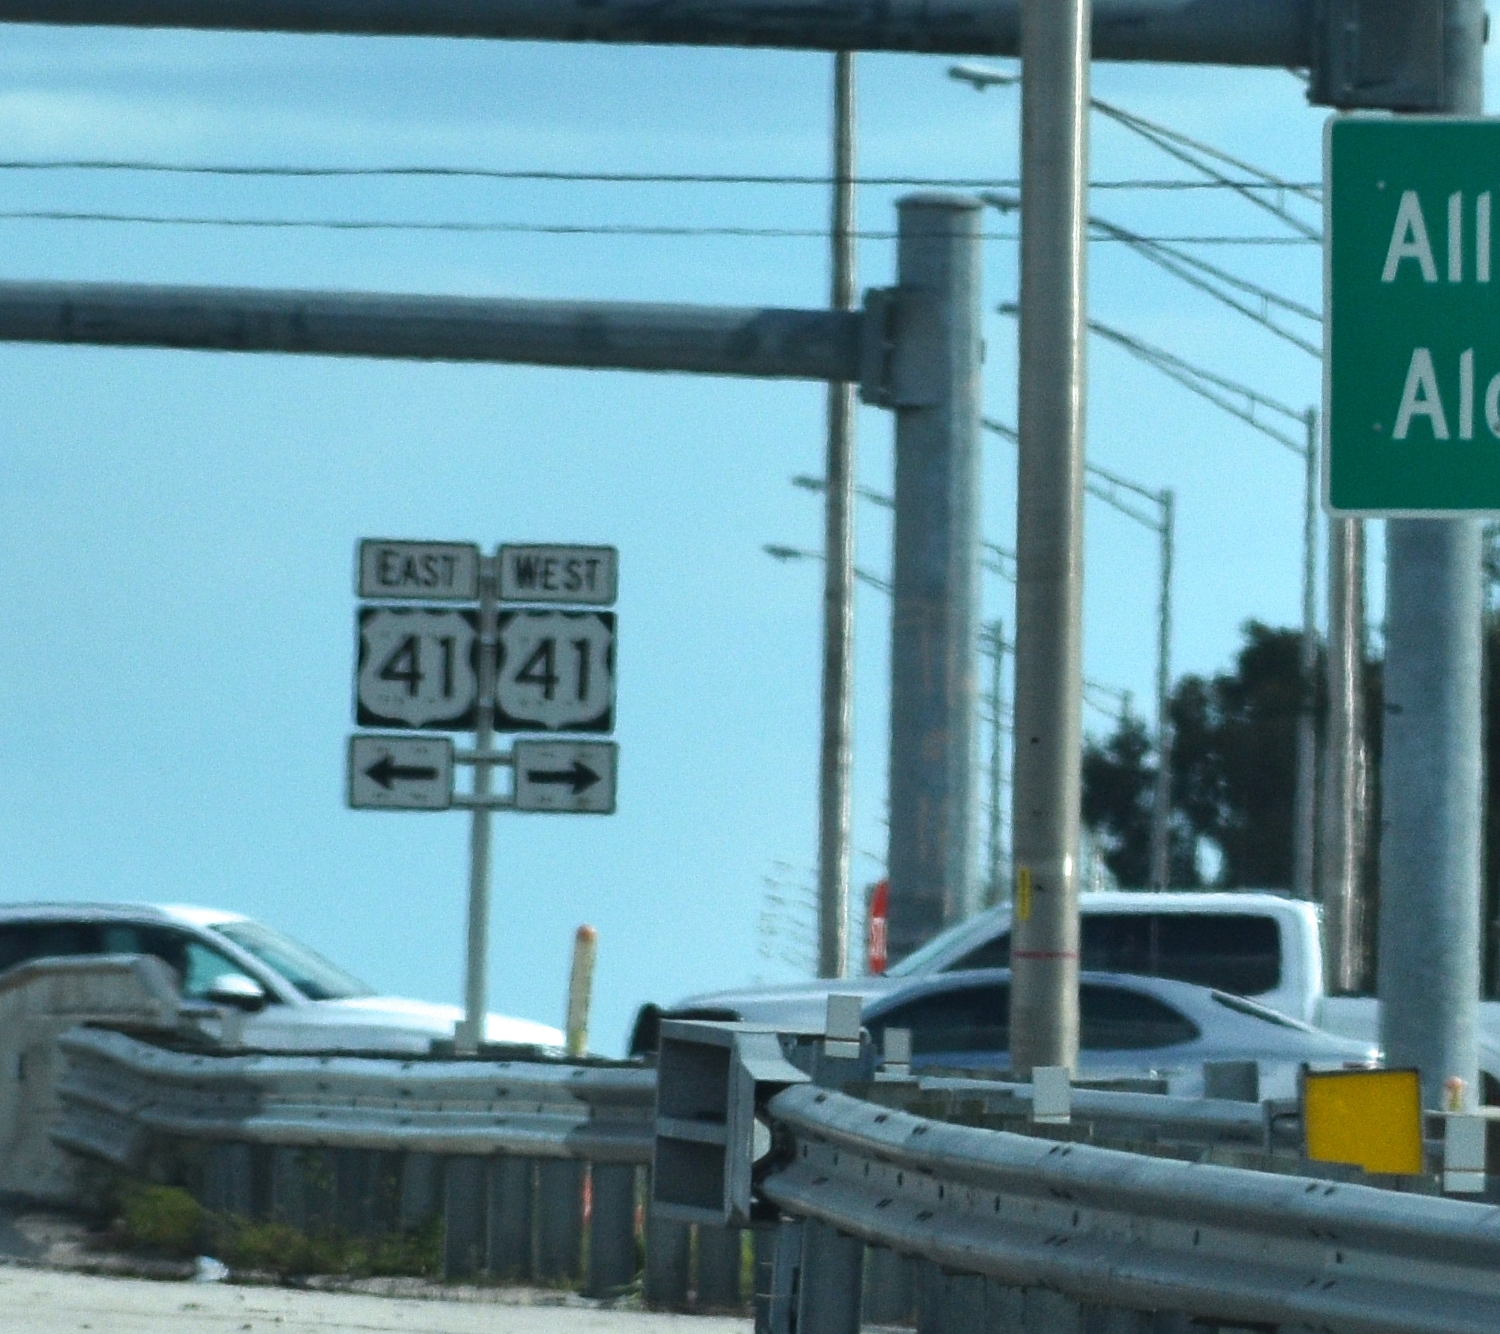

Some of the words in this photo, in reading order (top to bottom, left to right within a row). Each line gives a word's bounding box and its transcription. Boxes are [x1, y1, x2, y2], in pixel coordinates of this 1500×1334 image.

[377, 550, 457, 587] EAST
[514, 556, 601, 591] WEST
[378, 633, 457, 699] 41
[513, 638, 590, 702] 41
